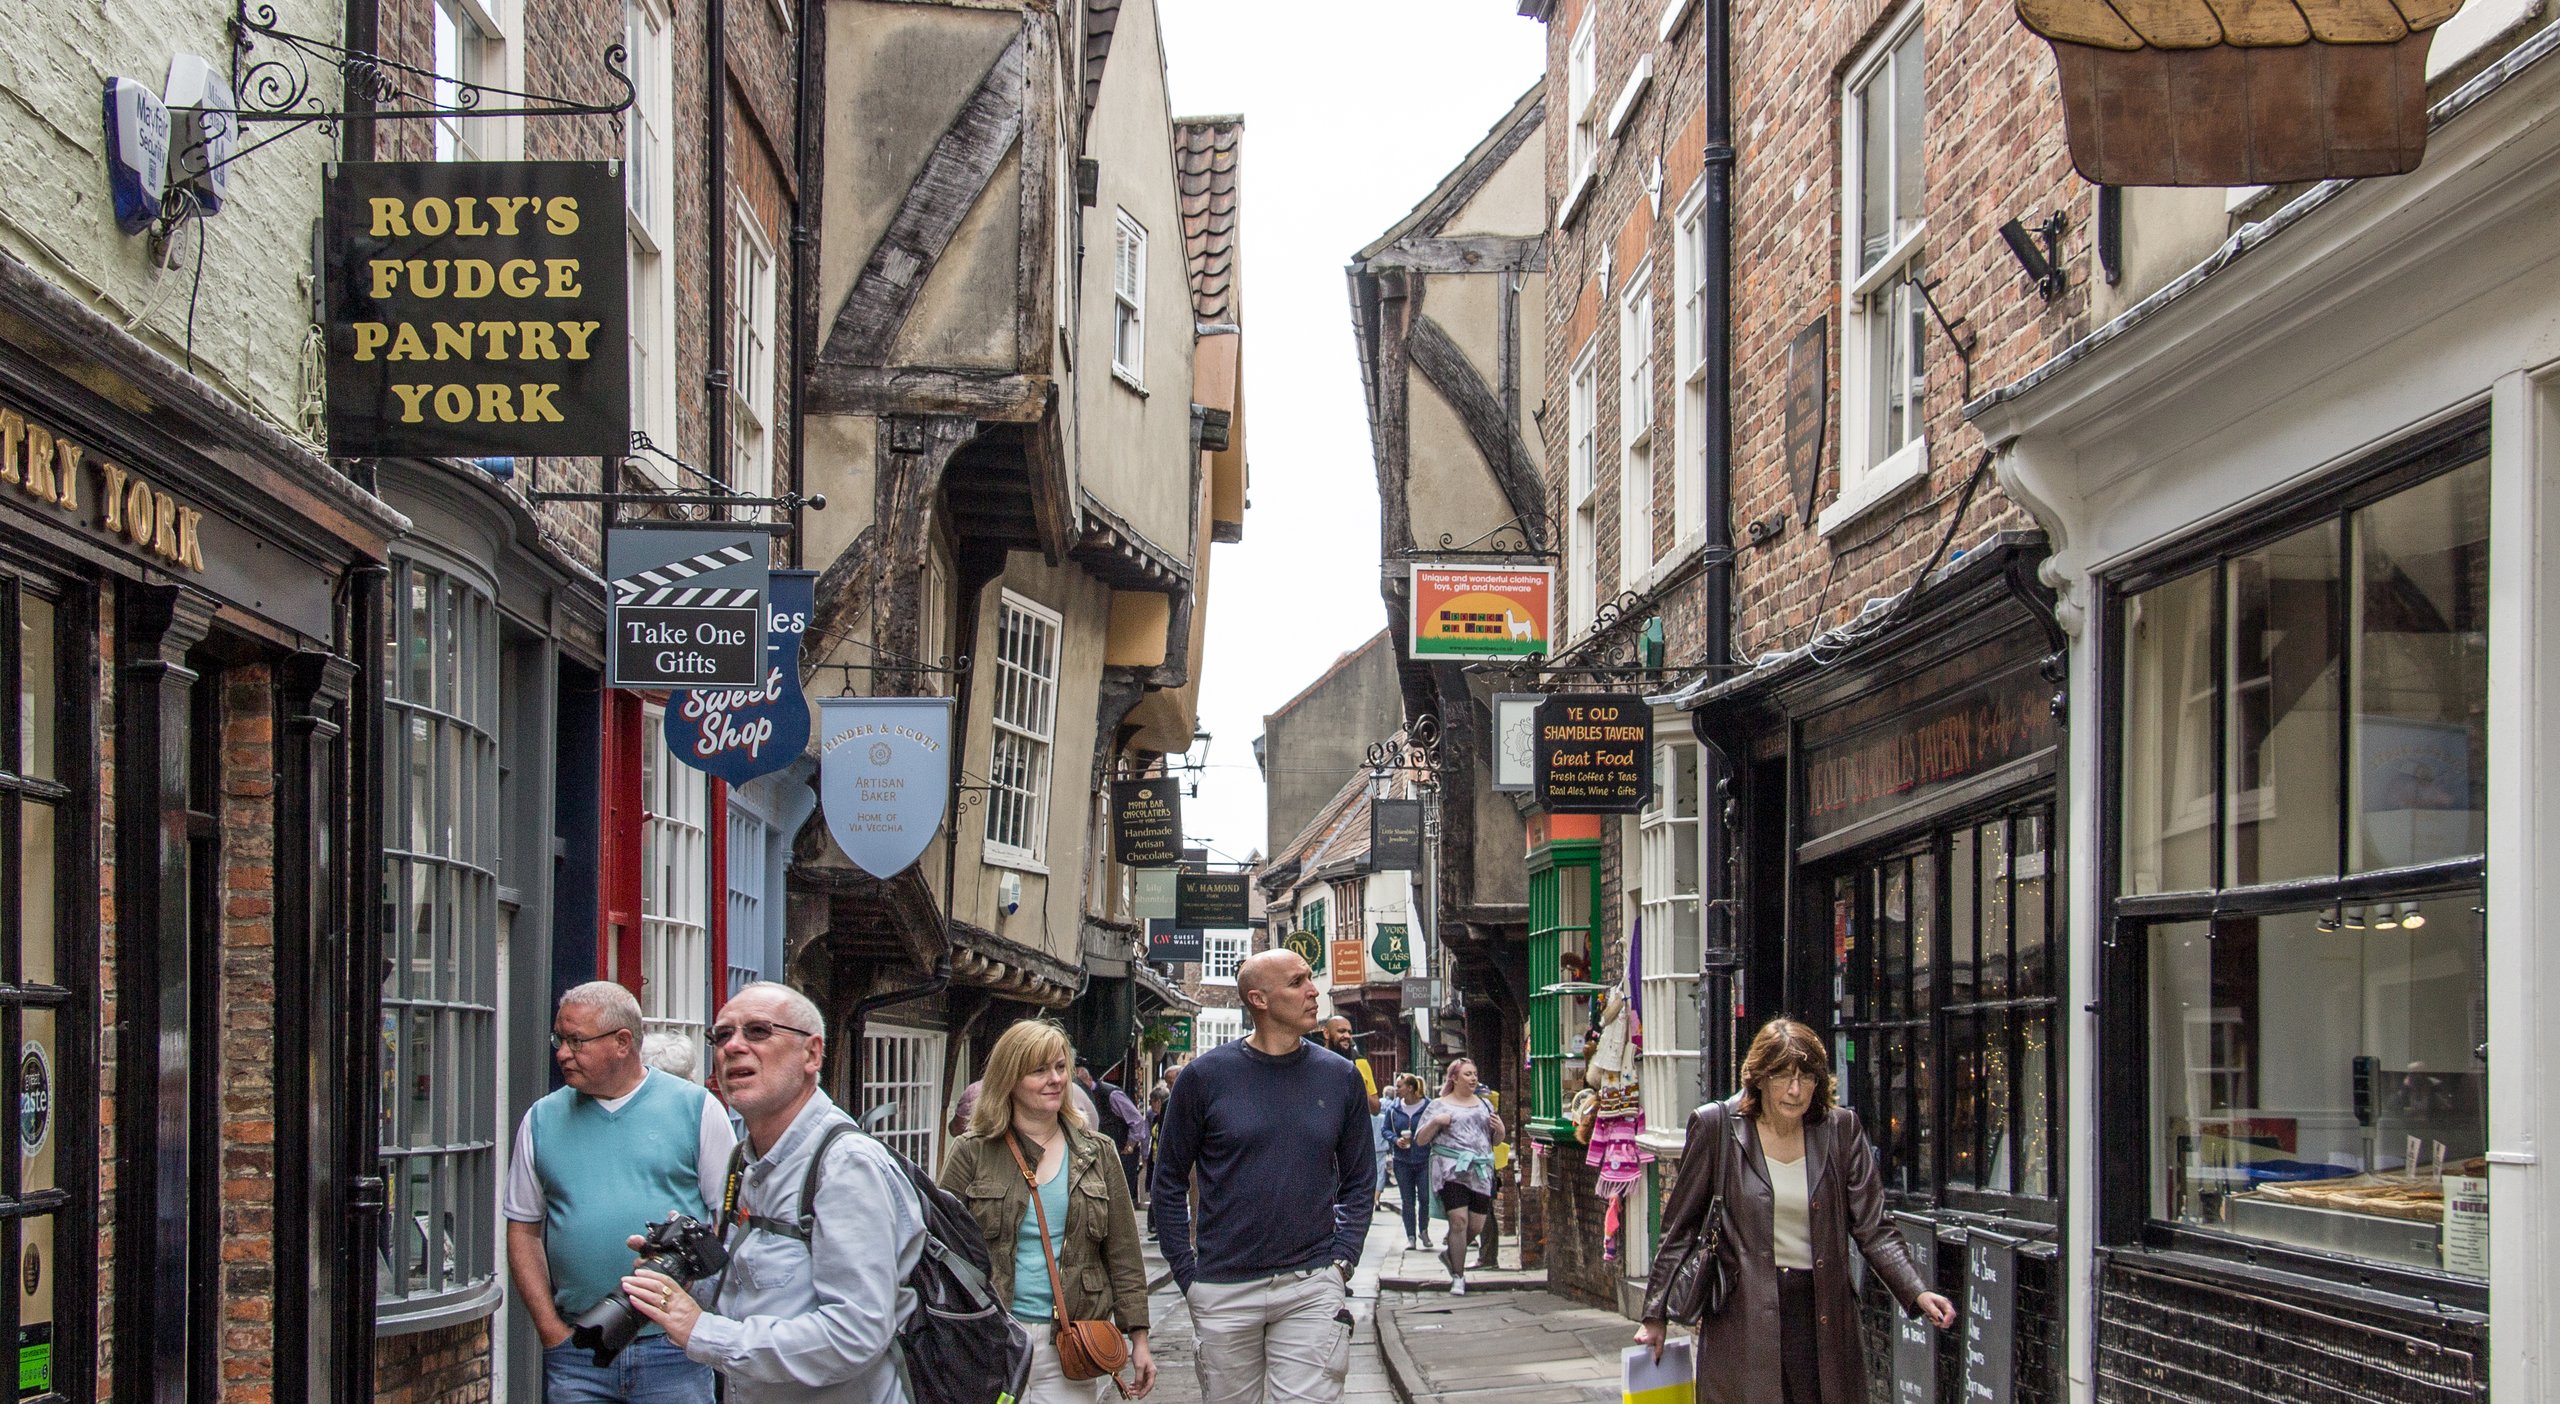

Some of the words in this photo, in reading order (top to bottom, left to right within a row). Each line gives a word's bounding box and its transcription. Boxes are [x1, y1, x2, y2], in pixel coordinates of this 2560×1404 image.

[137, 92, 168, 141] Mayfair
[139, 128, 166, 168] Security
[369, 196, 579, 236] ROLY'S
[369, 258, 582, 299] FUDGE
[352, 321, 600, 361] PANTRY
[392, 383, 564, 423] YORK
[103, 463, 204, 573] YORK
[1422, 573, 1449, 584] Unique
[1451, 574, 1467, 582] and
[1469, 574, 1508, 583] wonderful
[1509, 575, 1543, 585] clothing,
[1434, 583, 1452, 592] toys,
[1454, 583, 1470, 592] gifts
[1489, 584, 1531, 592] homeware
[627, 622, 688, 644] Take
[695, 623, 746, 646] One
[655, 651, 717, 674] Gifts
[1567, 707, 1584, 721] YE
[1589, 707, 1619, 721] OLD
[697, 711, 773, 759] Shop
[823, 724, 873, 754] PINDER
[879, 723, 889, 736] &
[895, 724, 941, 753] SCOTT
[1544, 726, 1602, 741] SHAMBLES
[1604, 726, 1645, 742] TAVERN
[1552, 749, 1591, 768] Great
[1595, 749, 1634, 767] Food
[1550, 771, 1575, 782] Fresh
[1577, 771, 1604, 782] Coffee
[1607, 771, 1614, 781] &
[1618, 771, 1637, 782] Teas
[855, 777, 904, 789] ARTISAN
[861, 790, 897, 802] BAKER
[1549, 785, 1566, 796] Real
[1567, 785, 1586, 797] Ales,
[1588, 785, 1609, 796] Wine
[1617, 786, 1637, 796] Gifts
[1128, 800, 1148, 810] MONK
[1149, 799, 1165, 809] BAR
[857, 812, 882, 822] HOME
[886, 813, 897, 822] OF
[1122, 808, 1171, 819] CHOCOLATIERS
[848, 823, 863, 832] VIA
[866, 823, 904, 832] VECCHIA
[1125, 826, 1173, 838] Handmade
[1134, 840, 1165, 849] Artisan
[1126, 851, 1174, 861] Chocolates
[1199, 884, 1240, 892] HAMOND
[1384, 926, 1407, 935] YORK
[1380, 953, 1409, 962] GLASS
[724, 1173, 736, 1211] Nikon
